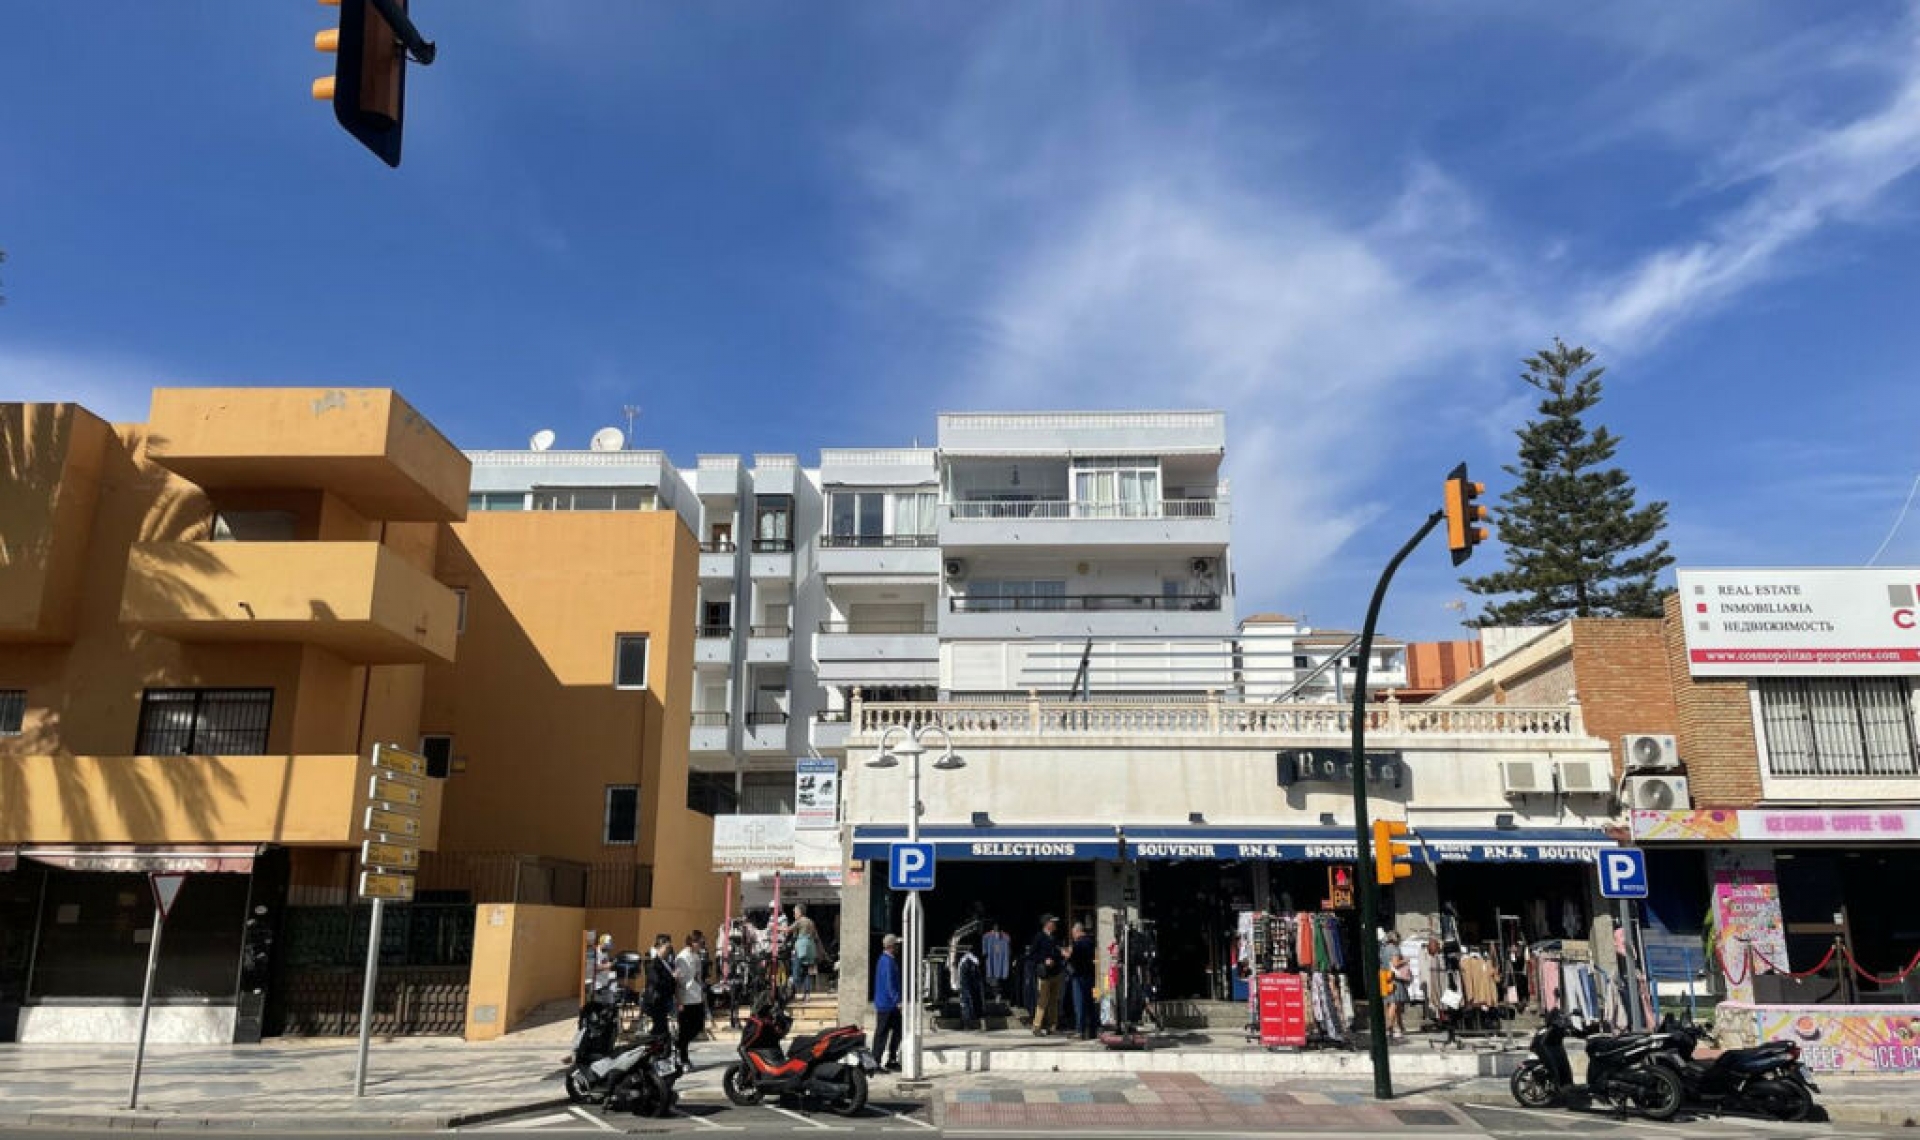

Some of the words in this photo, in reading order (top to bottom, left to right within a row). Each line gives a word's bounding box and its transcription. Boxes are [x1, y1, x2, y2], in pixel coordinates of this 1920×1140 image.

[1717, 585, 1752, 595] REAL
[1756, 585, 1801, 595] ESTATE
[1720, 603, 1813, 614] INMOBILIARIA
[1723, 621, 1834, 632] НЕДВИЖИМОСТЬ
[1705, 650, 1900, 663] www.cosmopolitan-properties.com
[971, 843, 1075, 856] SELECTIONS
[1137, 844, 1215, 857] SOUVENIR
[899, 848, 925, 883] P
[1607, 854, 1636, 891] P
